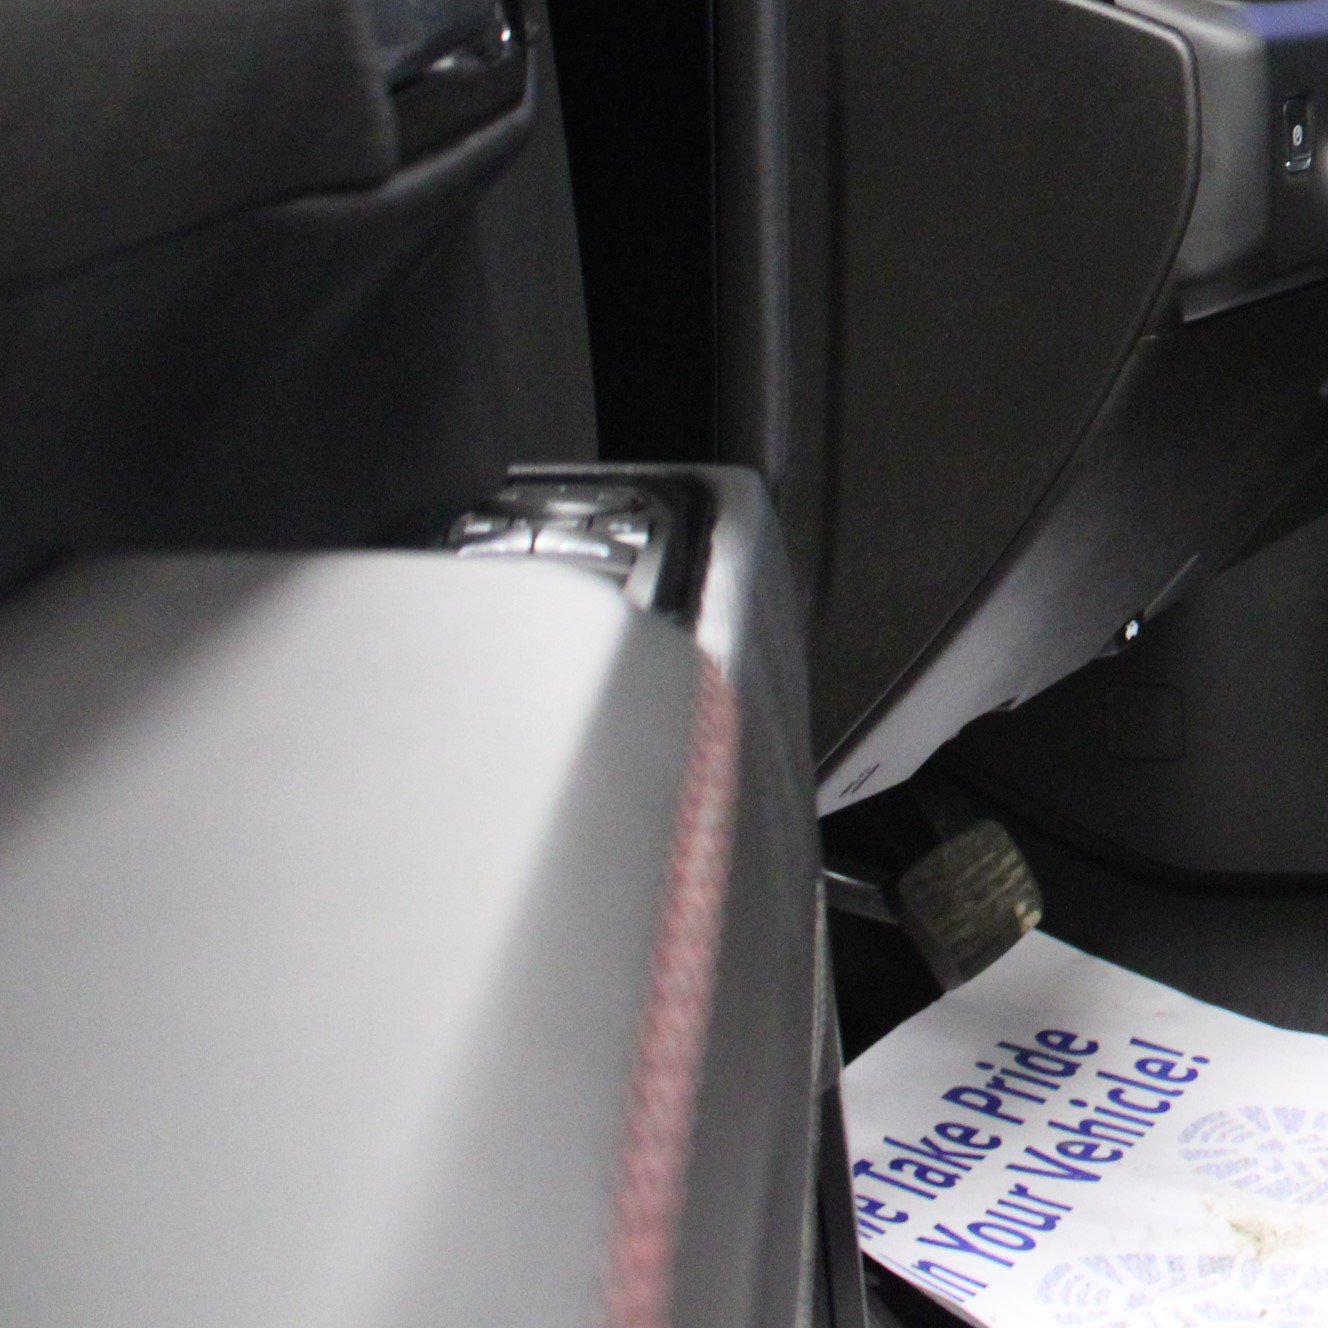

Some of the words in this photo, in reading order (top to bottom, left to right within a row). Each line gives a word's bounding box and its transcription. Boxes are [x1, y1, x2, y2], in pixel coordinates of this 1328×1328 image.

[853, 1122, 1002, 1200] Take
[941, 1028, 1099, 1126] Pride
[1005, 1036, 1211, 1182] Vehicle!
[880, 1252, 988, 1303] In
[916, 1183, 1074, 1268] Your
